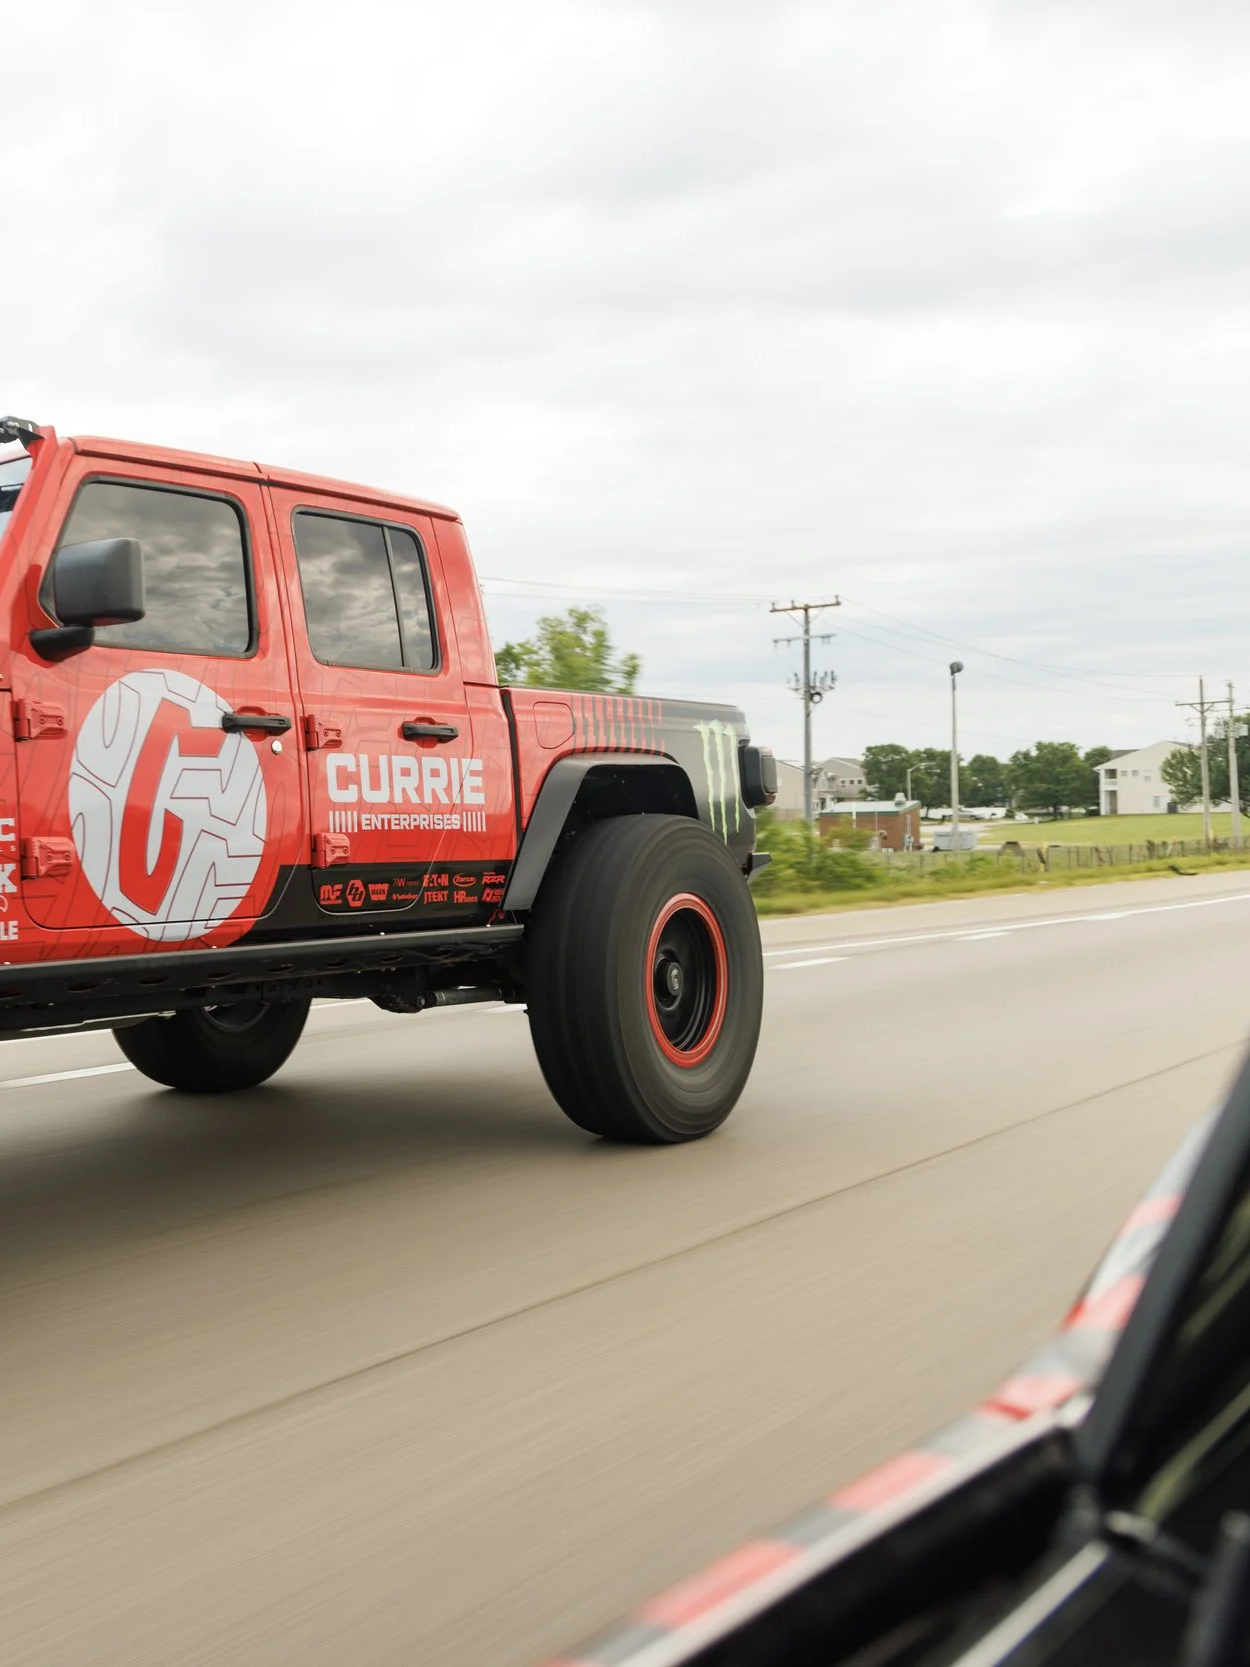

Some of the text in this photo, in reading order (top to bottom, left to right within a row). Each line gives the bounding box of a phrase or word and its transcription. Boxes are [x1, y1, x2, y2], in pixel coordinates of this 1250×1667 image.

[326, 753, 485, 804] CURRIE
[361, 813, 461, 830] ENTERPRISES
[423, 890, 449, 904] JTEKT
